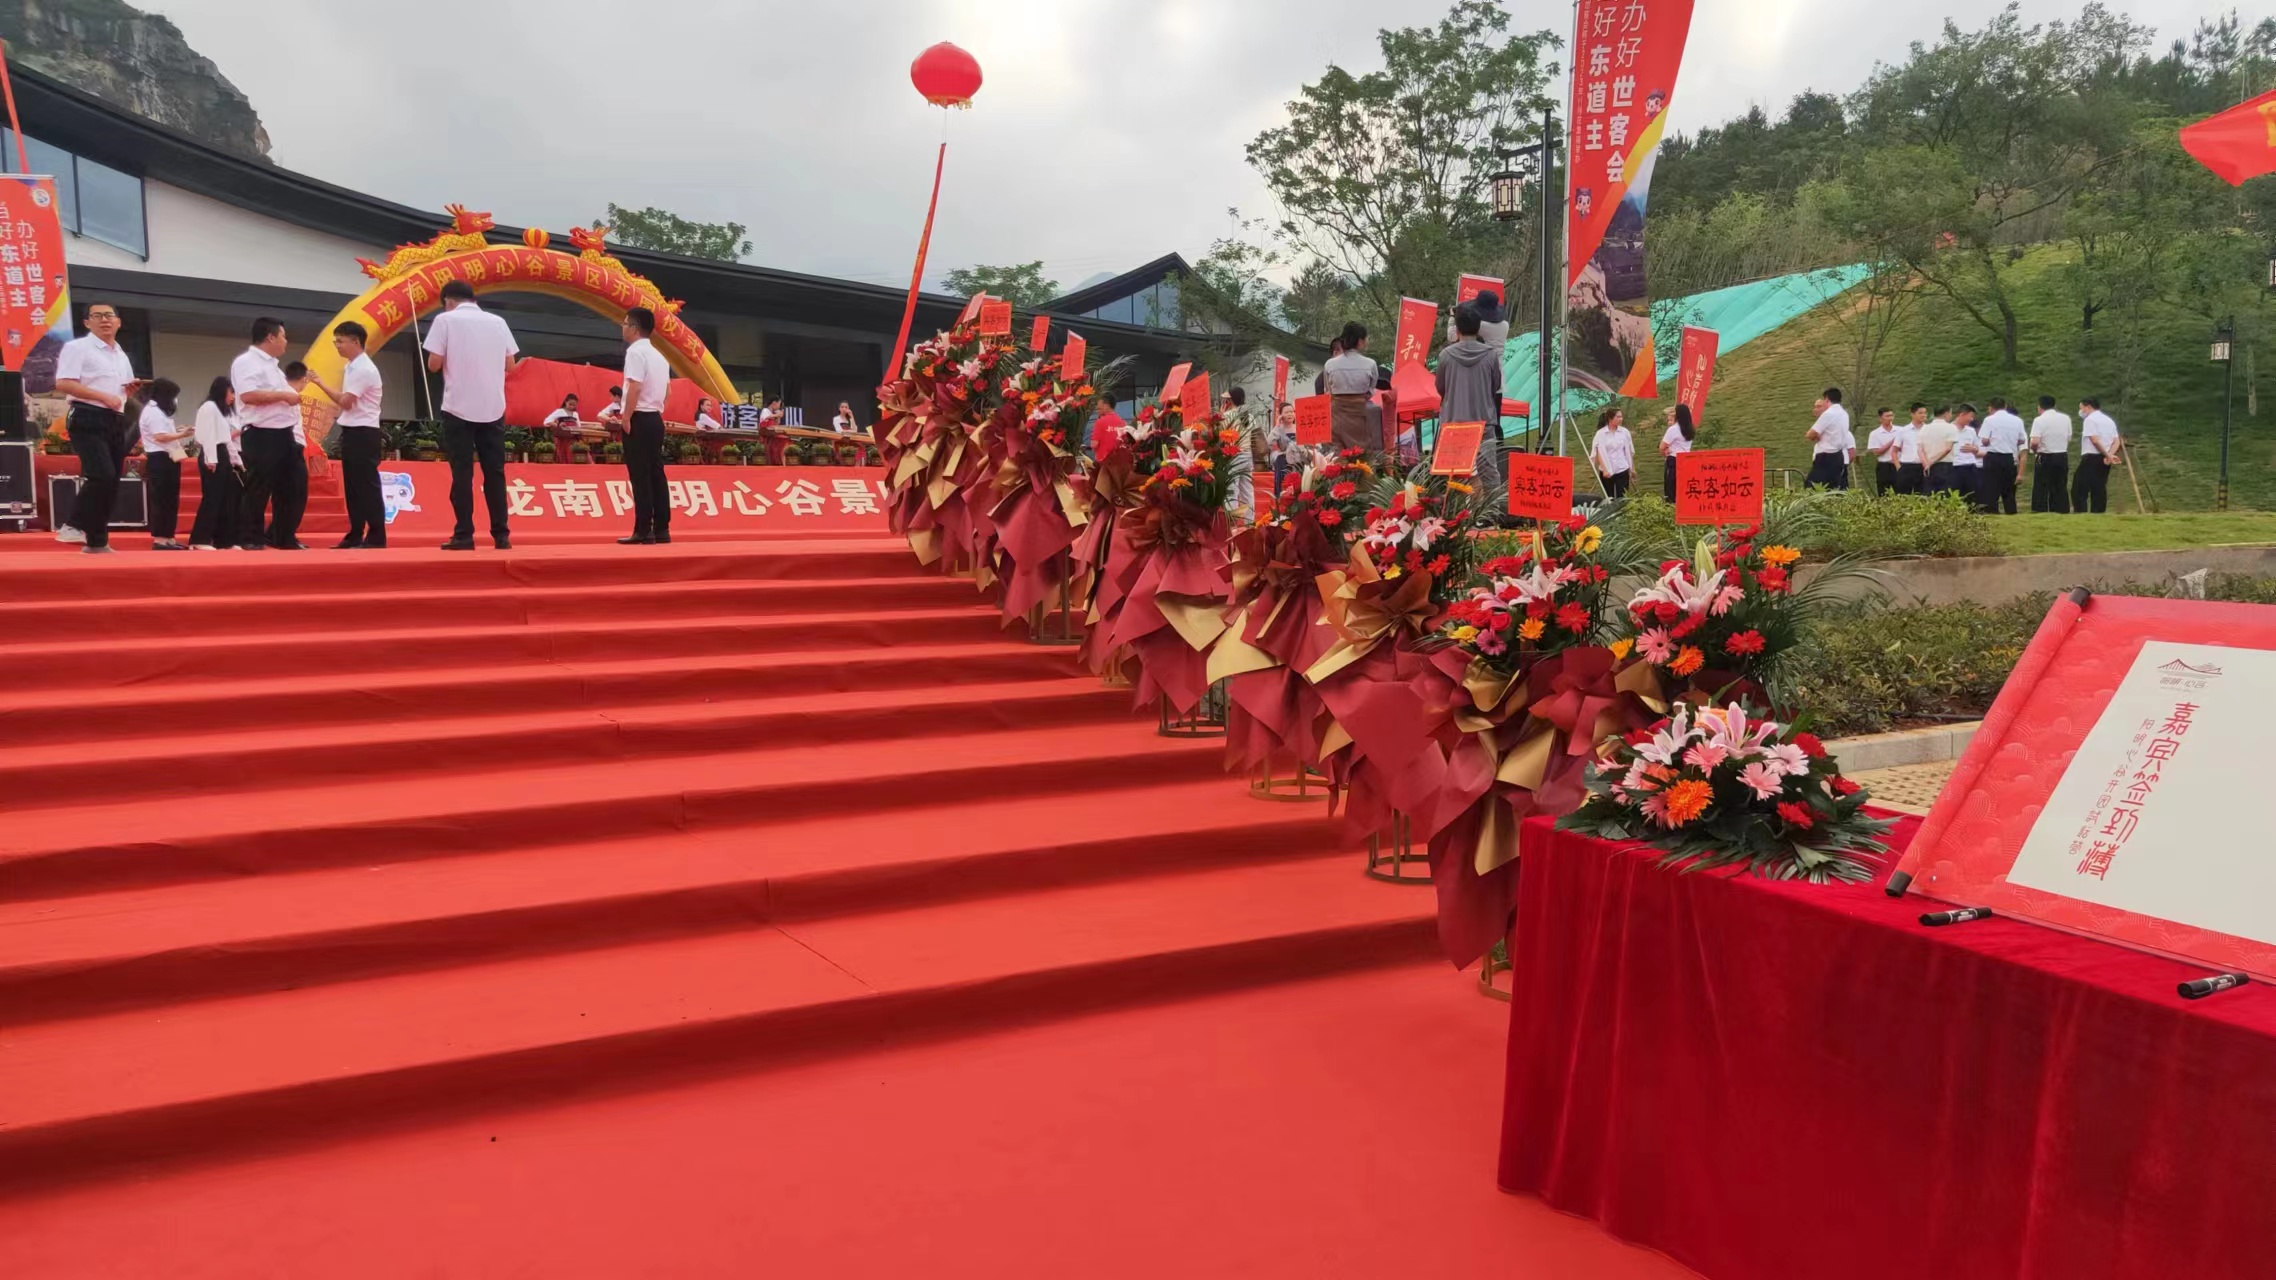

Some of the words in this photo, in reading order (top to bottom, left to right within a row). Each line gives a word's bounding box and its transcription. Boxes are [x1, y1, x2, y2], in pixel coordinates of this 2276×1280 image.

[1607, 0, 1646, 183] 办好世客会
[16, 219, 46, 326] 办好世客会
[506, 478, 888, 518] 龙南阳明心谷景
[1515, 475, 1565, 499] 宾客如云
[1685, 476, 1754, 500] 宾客如云
